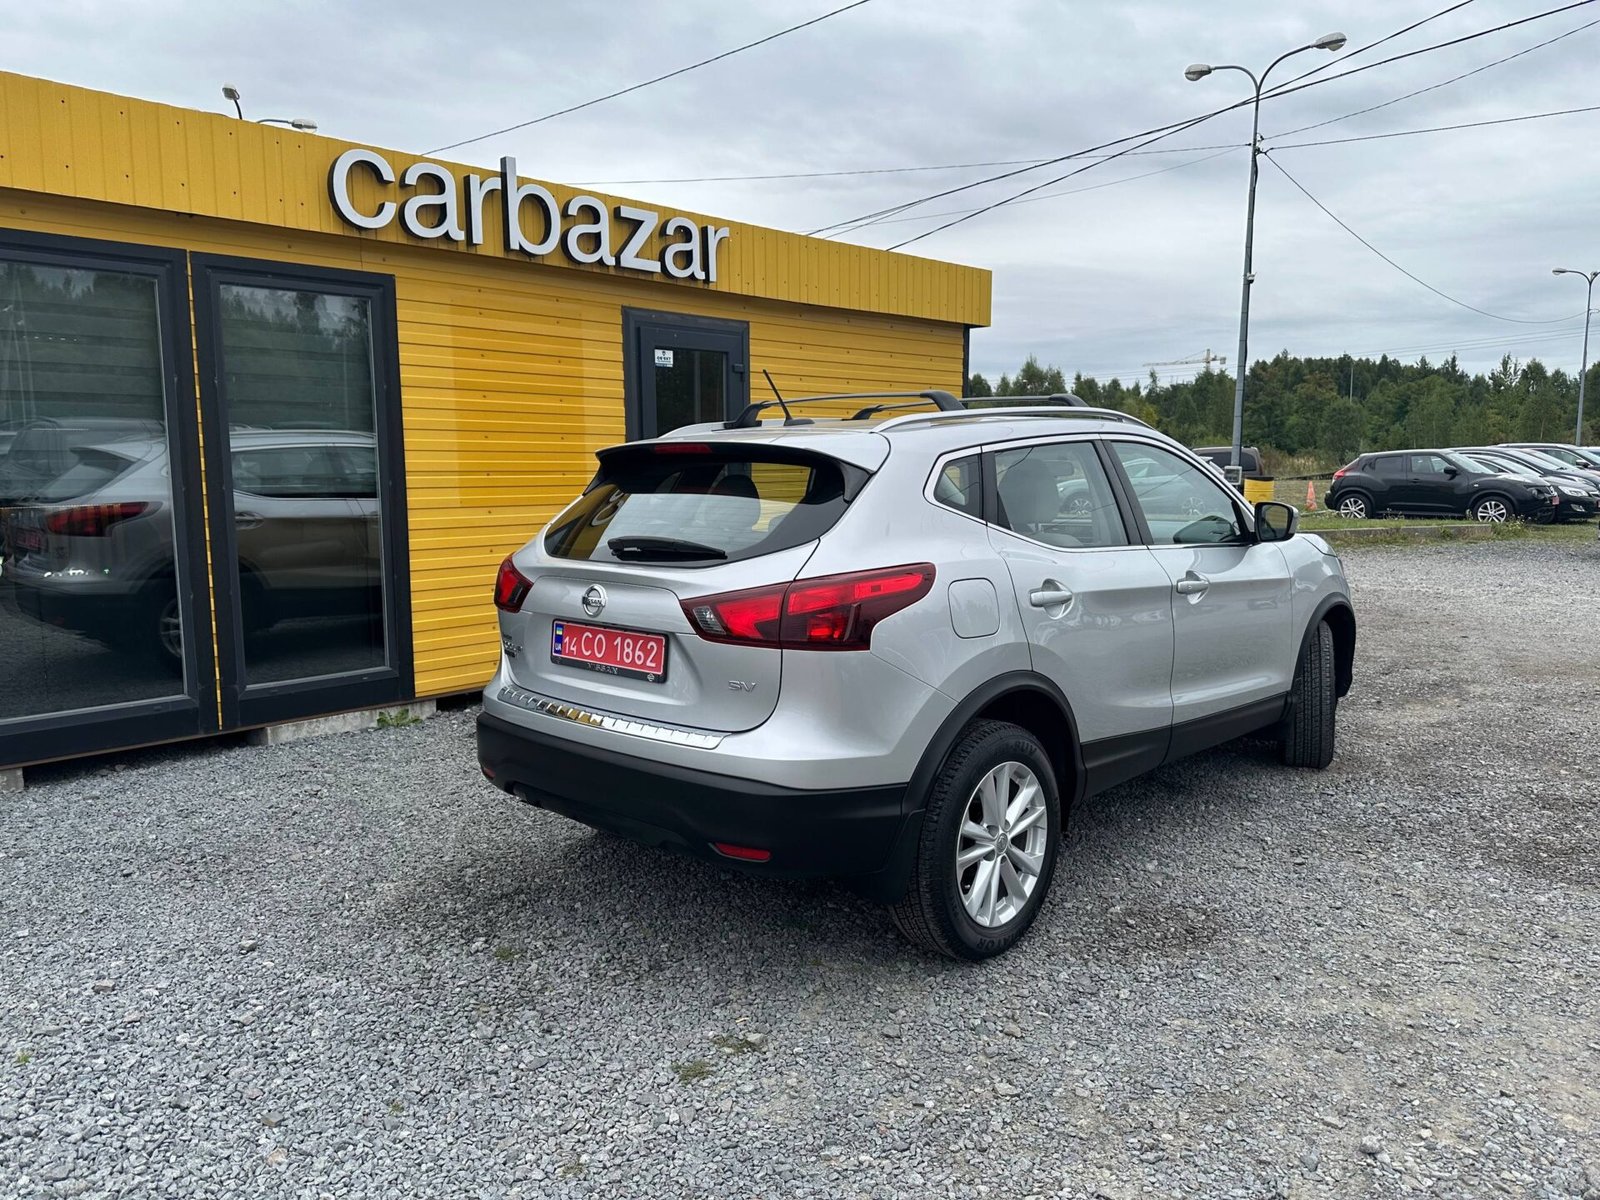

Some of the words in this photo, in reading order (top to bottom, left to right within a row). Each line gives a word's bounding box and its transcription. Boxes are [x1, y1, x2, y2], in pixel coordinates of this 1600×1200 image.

[329, 149, 730, 283] carbazar
[555, 642, 562, 651] UA
[564, 636, 577, 655] 14
[581, 632, 606, 658] CO
[613, 636, 658, 668] 1862
[728, 680, 757, 693] SV
